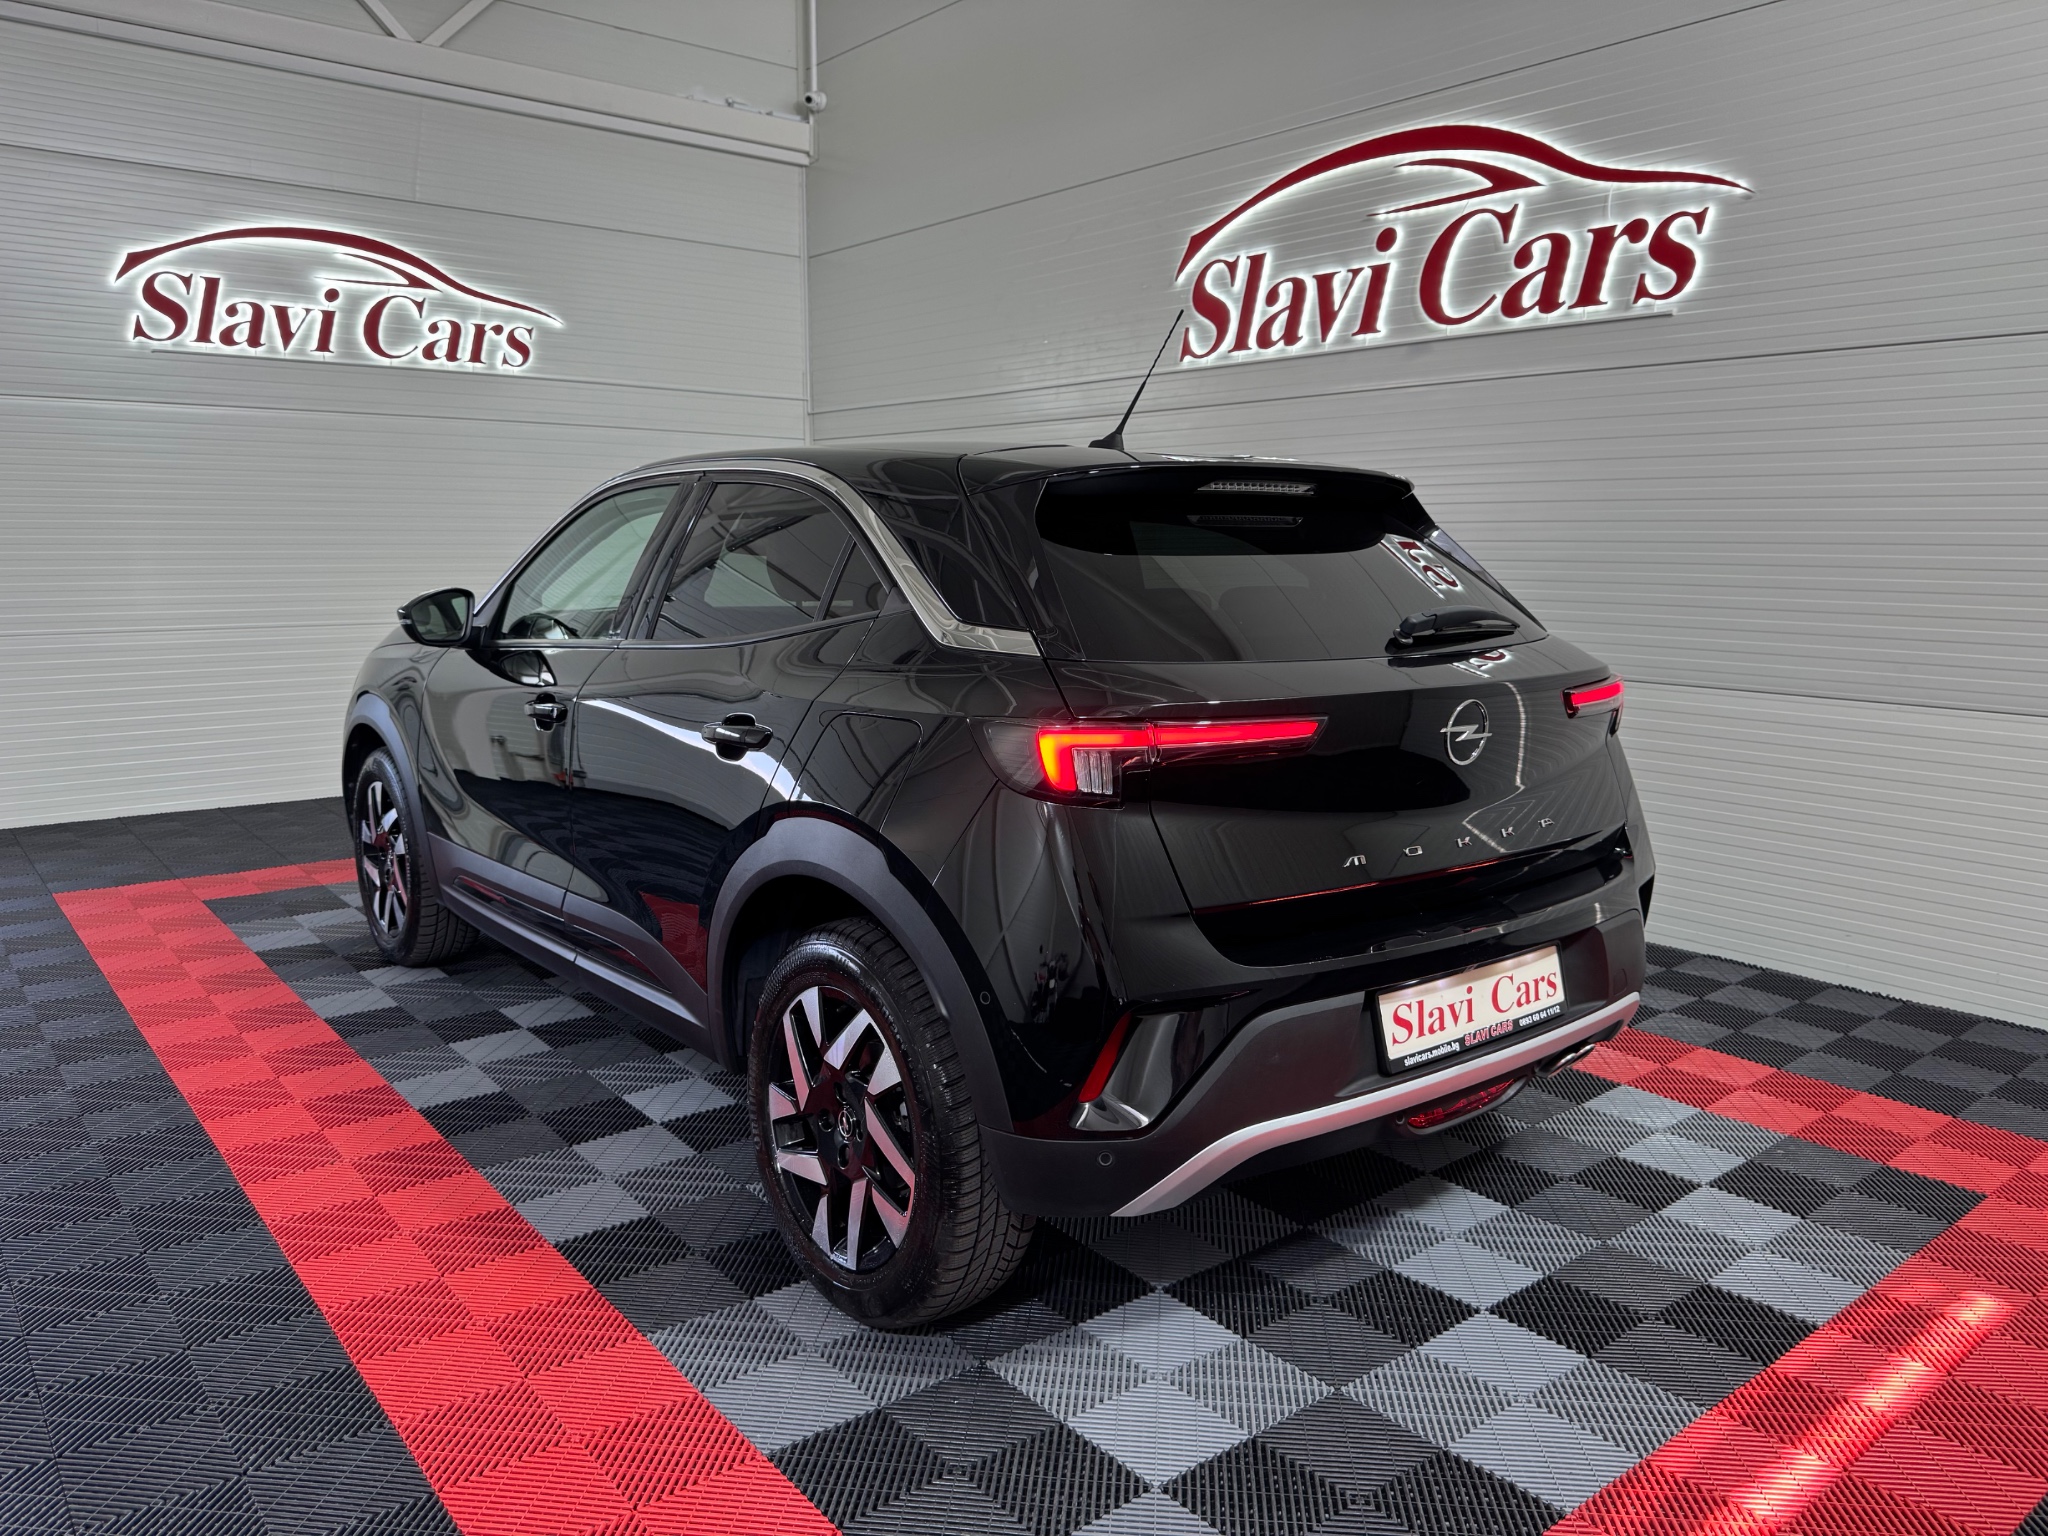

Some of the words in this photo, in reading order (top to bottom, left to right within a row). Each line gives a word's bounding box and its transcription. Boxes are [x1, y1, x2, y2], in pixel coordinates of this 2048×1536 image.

[132, 271, 341, 354] Slavi
[362, 295, 537, 370] Cars
[1180, 227, 1399, 362] Slavi
[1419, 203, 1712, 326] Cars
[1342, 817, 1555, 868] MOKKA
[1391, 985, 1475, 1047] Slavi
[1490, 971, 1558, 1014] Cars
[1464, 1028, 1490, 1046] SLAVI
[1490, 1019, 1514, 1038] CARS
